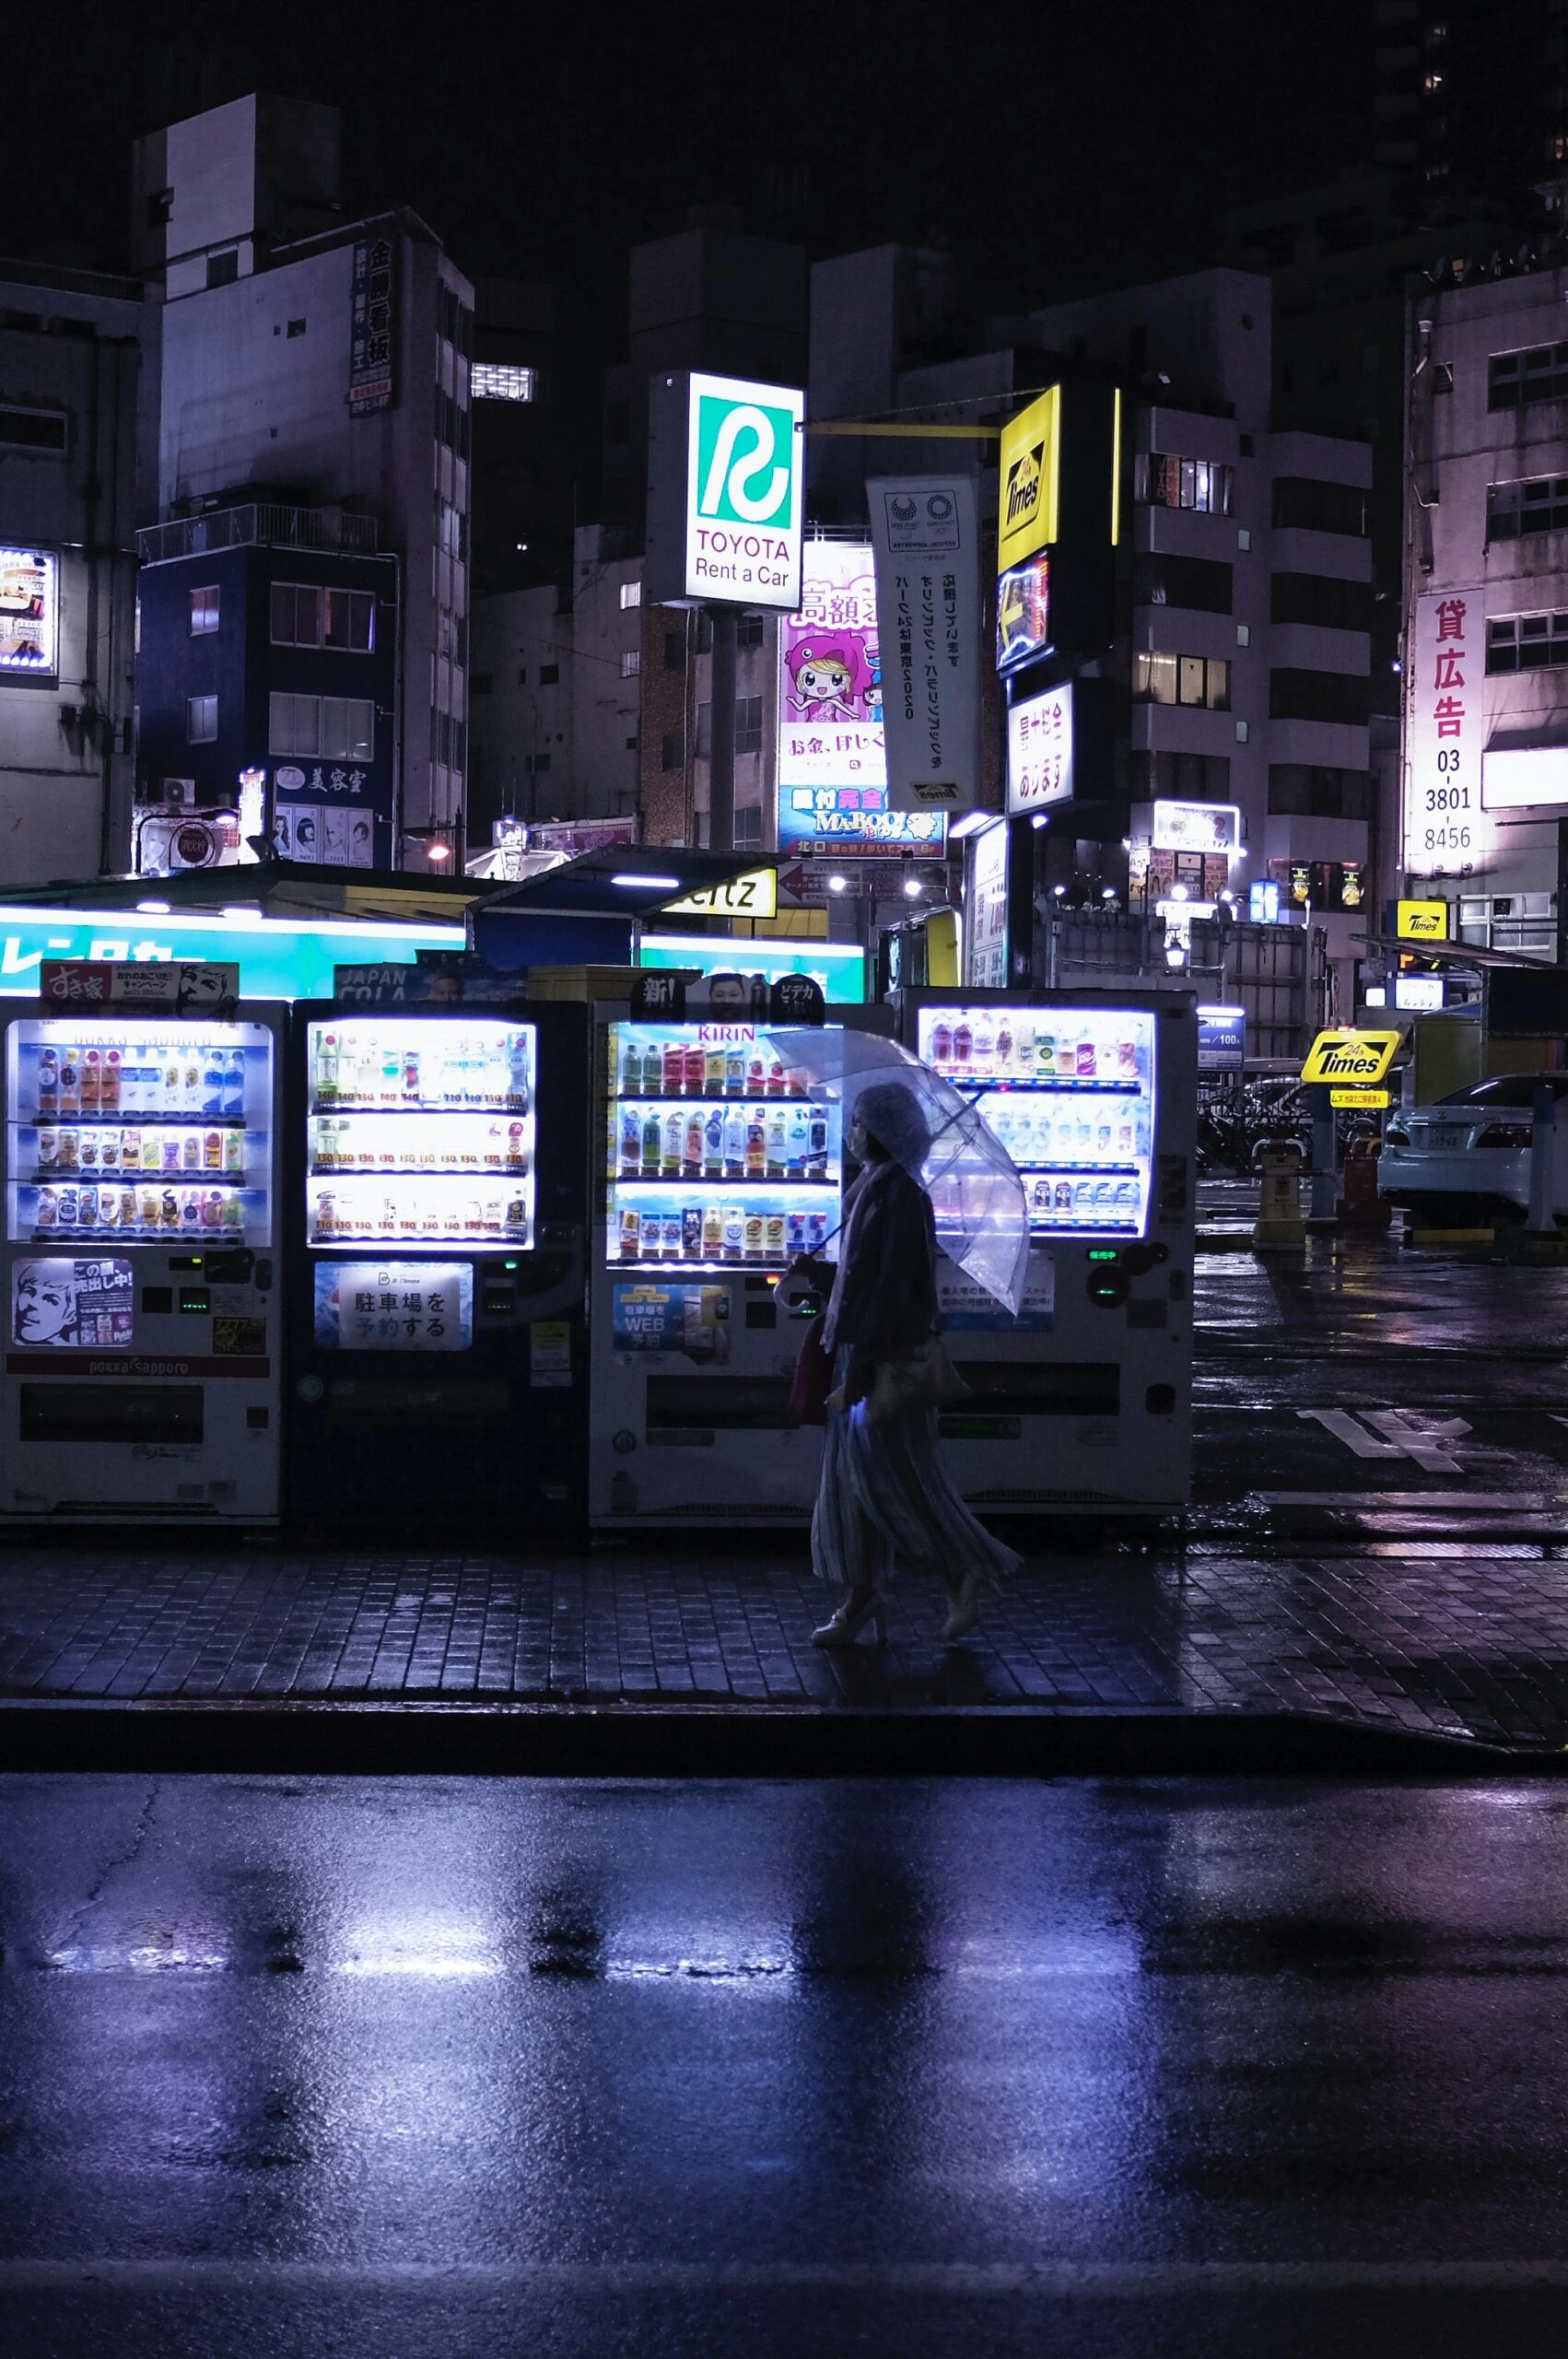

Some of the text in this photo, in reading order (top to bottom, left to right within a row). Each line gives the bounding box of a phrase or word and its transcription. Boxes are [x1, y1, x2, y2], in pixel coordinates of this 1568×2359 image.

[696, 530, 790, 561] TOYOTA
[696, 557, 789, 587] Rent a Car
[1433, 600, 1467, 739] 貸広告
[1437, 749, 1460, 772] 03
[308, 767, 367, 792] 美容室
[1426, 788, 1471, 812] 3801
[798, 840, 826, 852] 北口
[1425, 827, 1471, 850] 8456
[1409, 917, 1438, 931] Times
[1399, 954, 1414, 968] P
[50, 967, 104, 1000] すき家
[342, 970, 406, 985] JAPAN
[698, 1026, 755, 1041] KIRIN
[1344, 1044, 1363, 1056] 24h
[1317, 1048, 1384, 1074] Times
[355, 1292, 445, 1313] 駐車場を
[356, 1317, 444, 1337] 予約する
[625, 1317, 665, 1332] WEB
[89, 1361, 189, 1375] pokka sapporo
